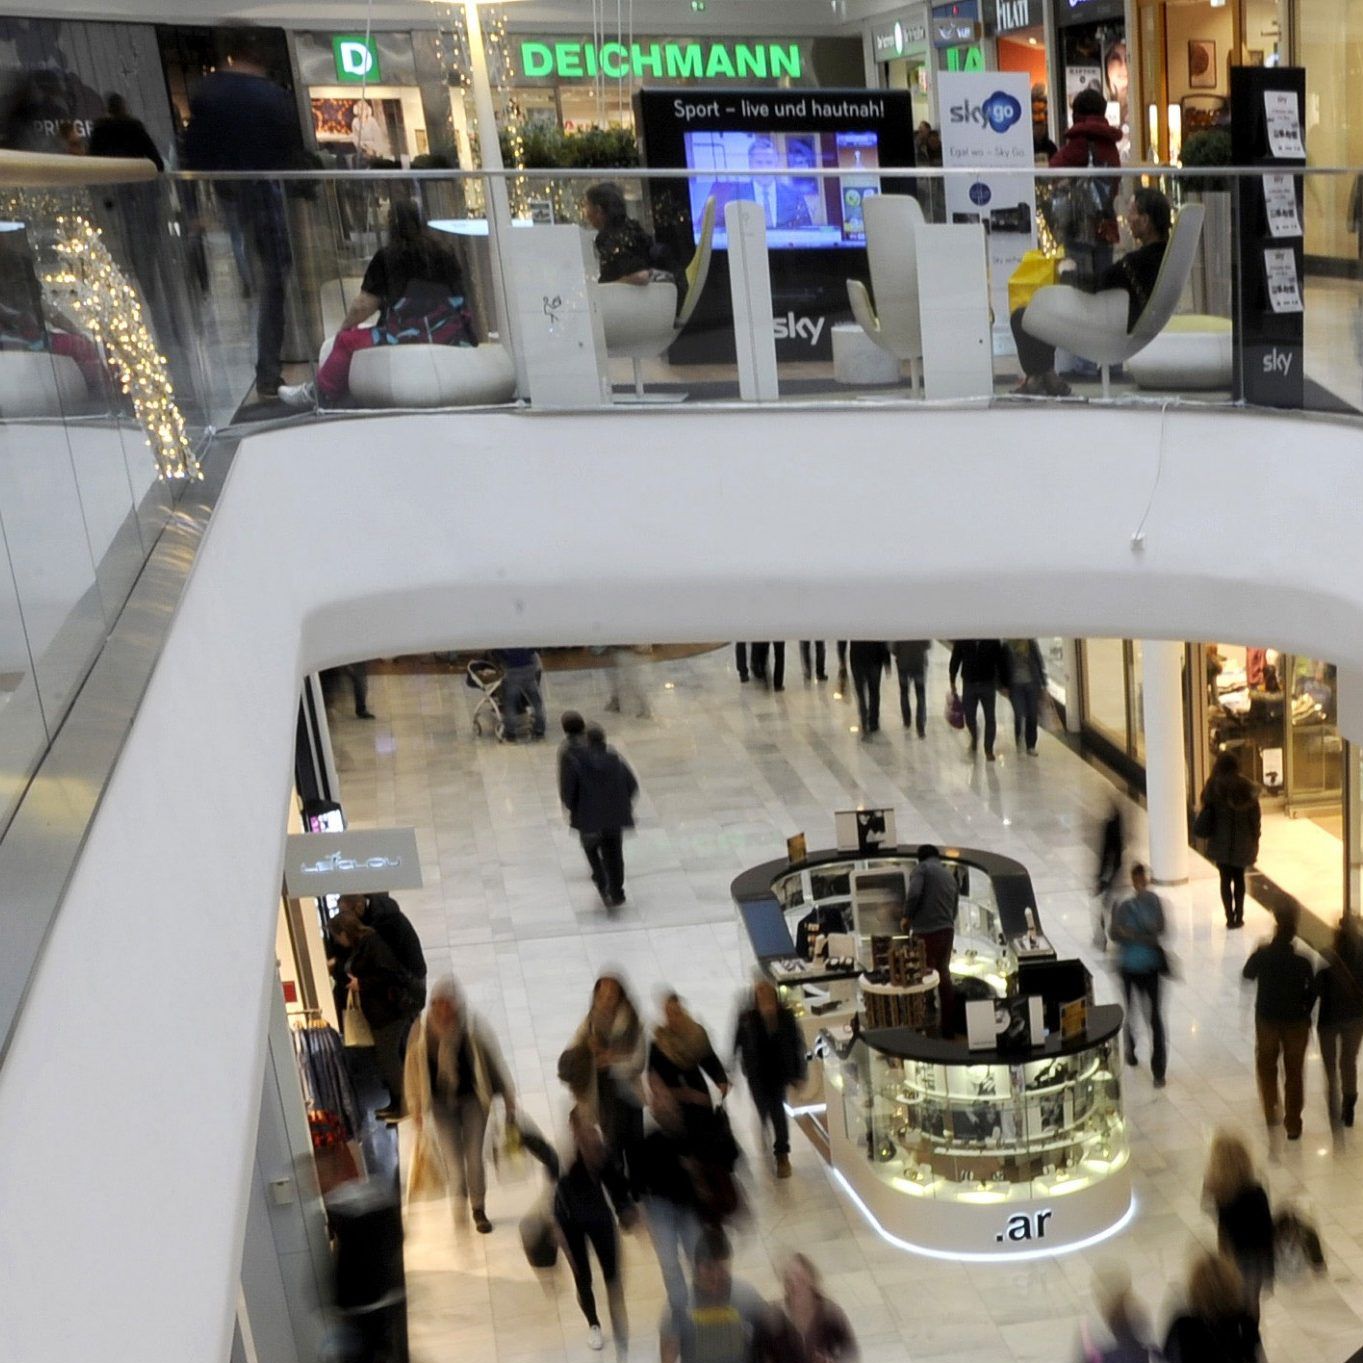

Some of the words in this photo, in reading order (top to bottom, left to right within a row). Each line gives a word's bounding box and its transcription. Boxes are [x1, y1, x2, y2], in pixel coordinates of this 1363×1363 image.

[340, 42, 373, 75] D
[521, 43, 801, 78] DEICHMANN
[674, 100, 720, 121] Sport
[741, 100, 769, 117] live
[775, 100, 806, 117] und
[812, 100, 885, 118] hautnah!
[993, 105, 1014, 123] go
[772, 311, 825, 346] sky
[1262, 347, 1292, 376] sky
